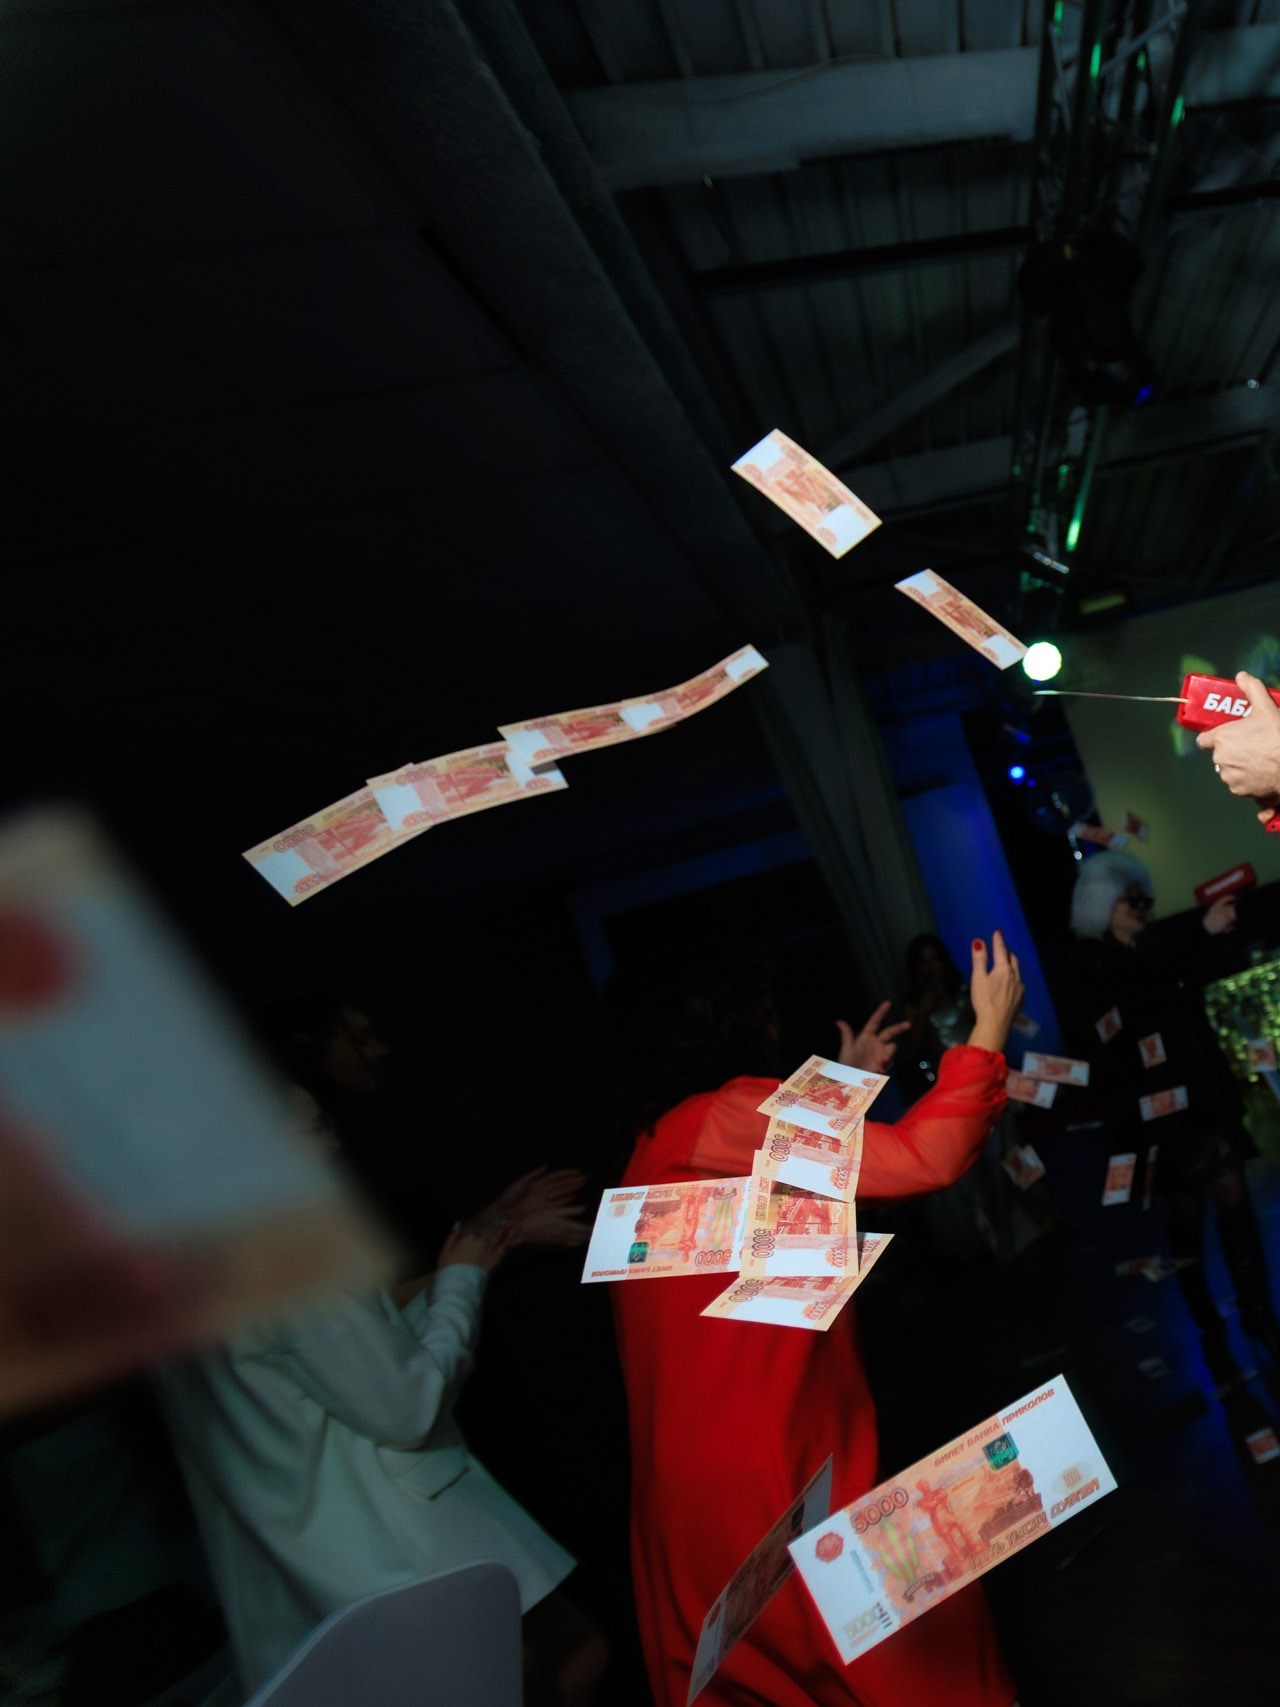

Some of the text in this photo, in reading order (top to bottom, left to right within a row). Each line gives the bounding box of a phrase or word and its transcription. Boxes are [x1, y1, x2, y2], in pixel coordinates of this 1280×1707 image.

[769, 1134, 791, 1162] 5000
[694, 1249, 732, 1267] 5000
[752, 1228, 775, 1258] 5000
[934, 1388, 1055, 1467] БИЛЕТ БАНКА ПРИКОЛОВ
[851, 1487, 909, 1534] 5000
